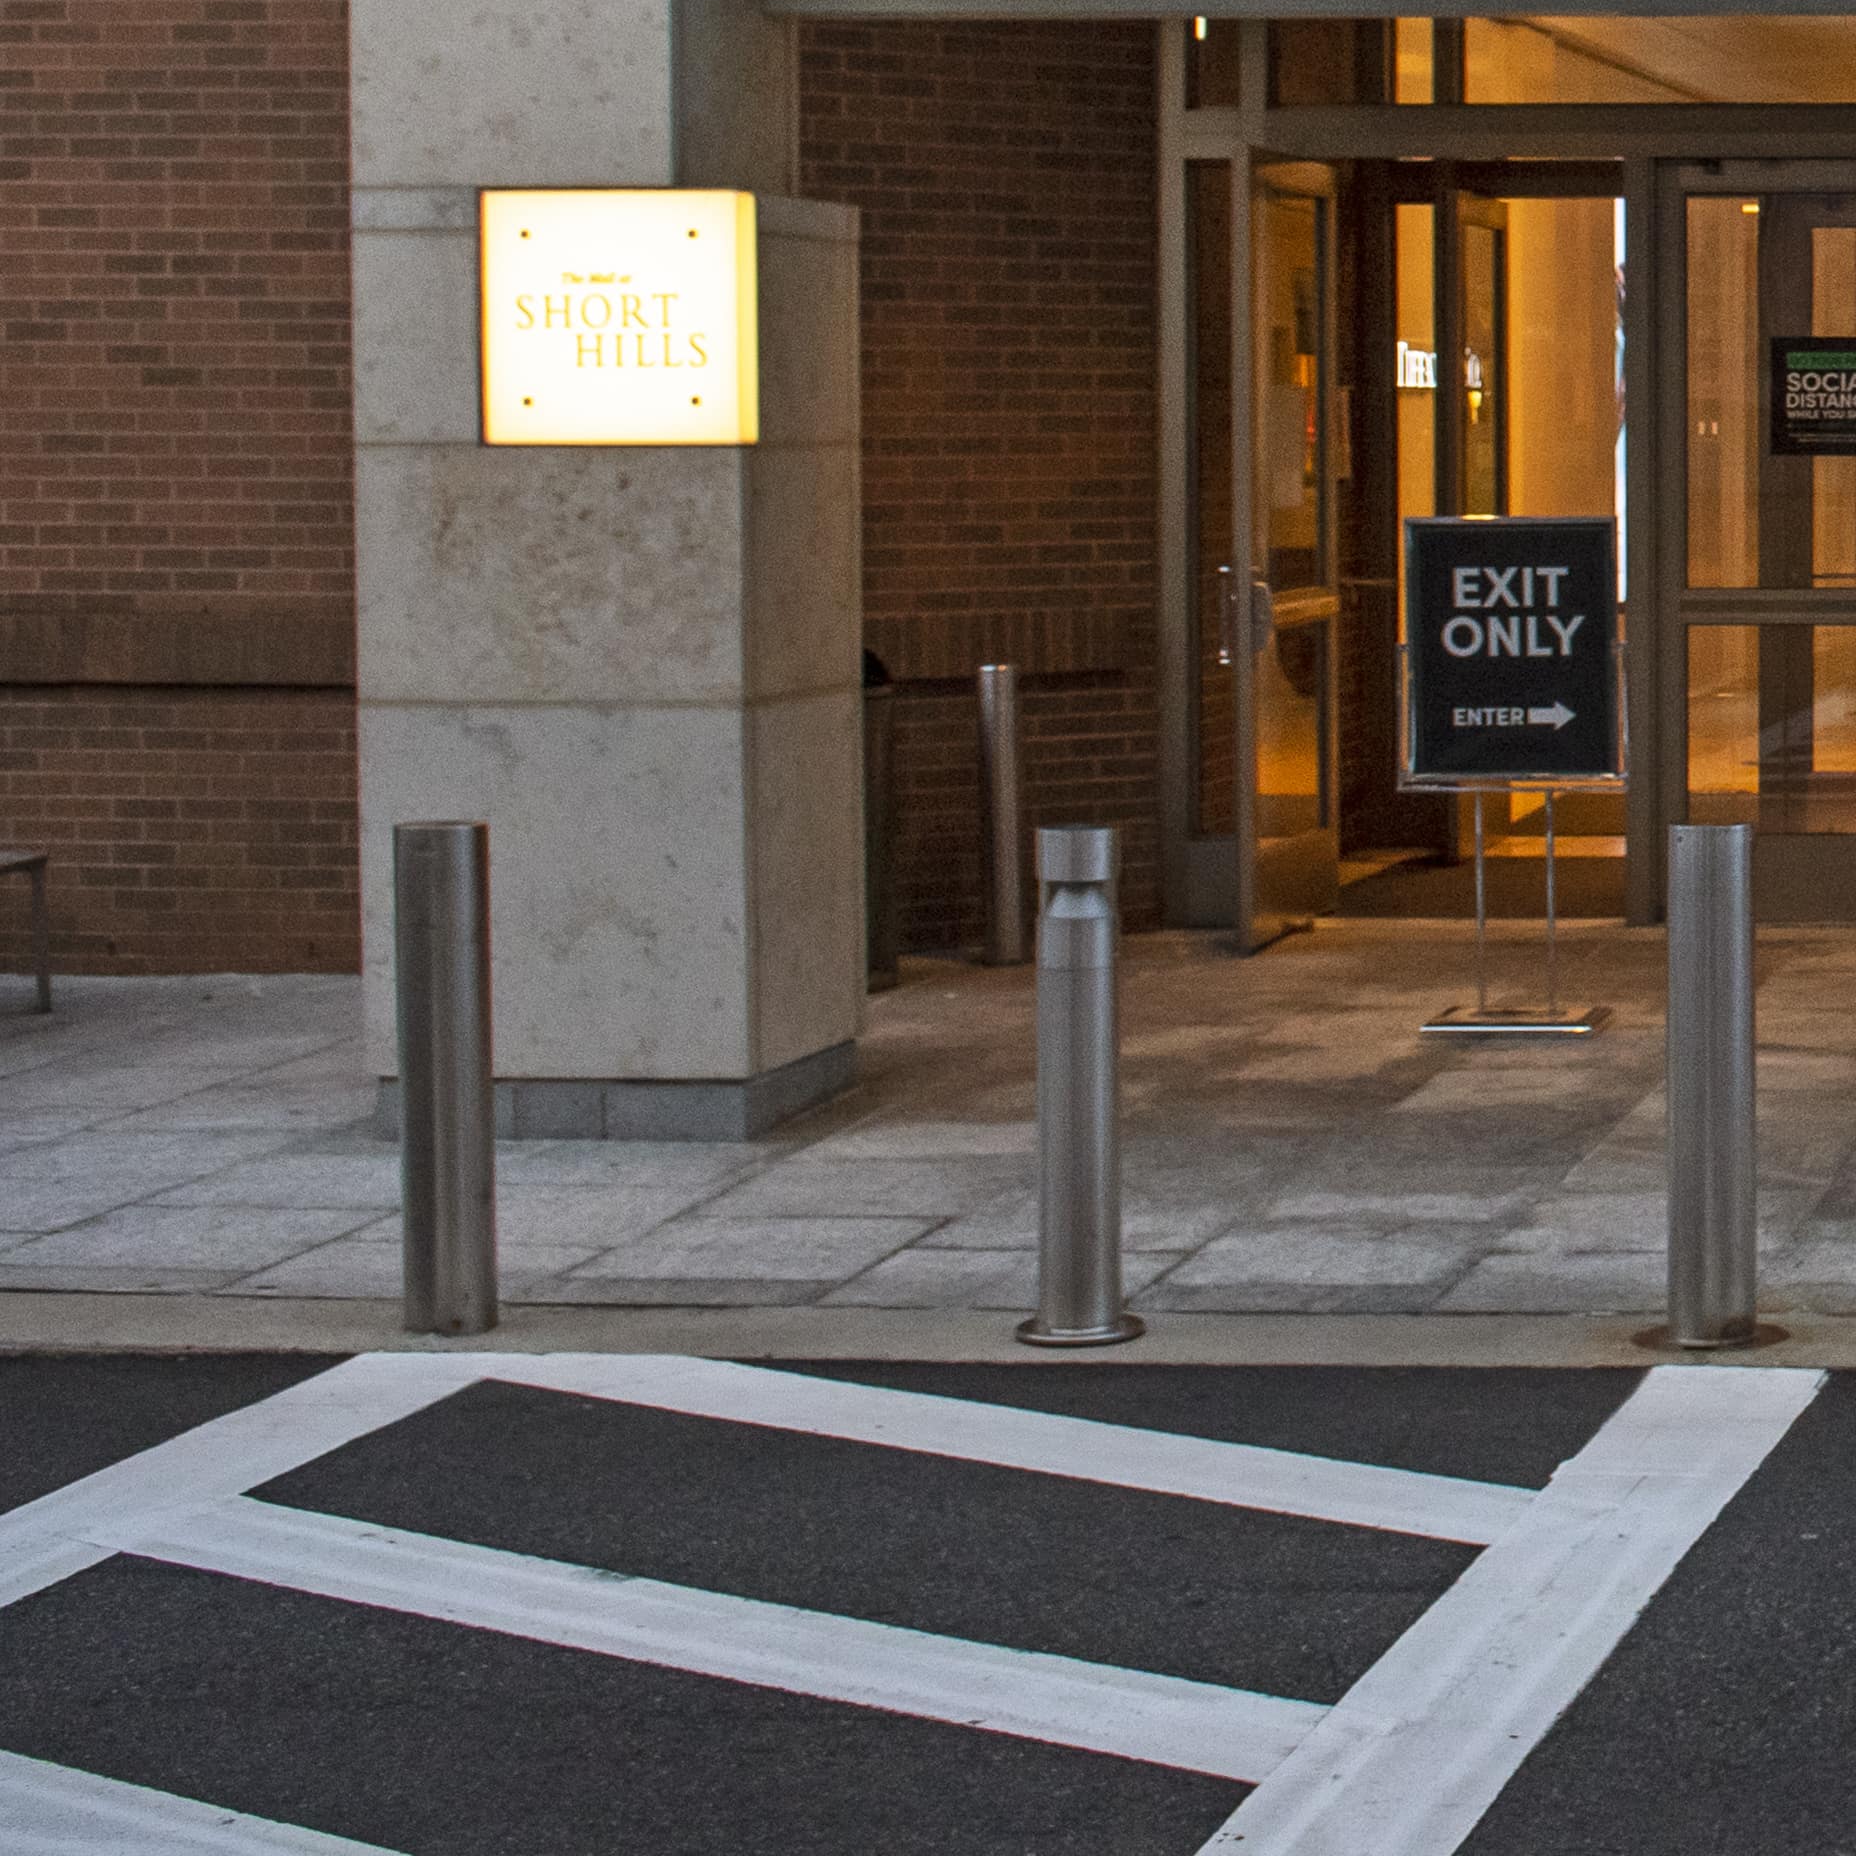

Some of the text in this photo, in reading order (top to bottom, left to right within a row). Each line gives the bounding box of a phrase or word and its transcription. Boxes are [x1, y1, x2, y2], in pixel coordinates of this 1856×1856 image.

[515, 293, 679, 329] SHORT
[576, 333, 709, 368] HILLS
[1786, 410, 1820, 420] WHILE
[1822, 410, 1846, 420] YOU
[1453, 566, 1569, 608] EXIT
[1441, 615, 1586, 657] ONLY
[1453, 707, 1525, 726] ENTER
